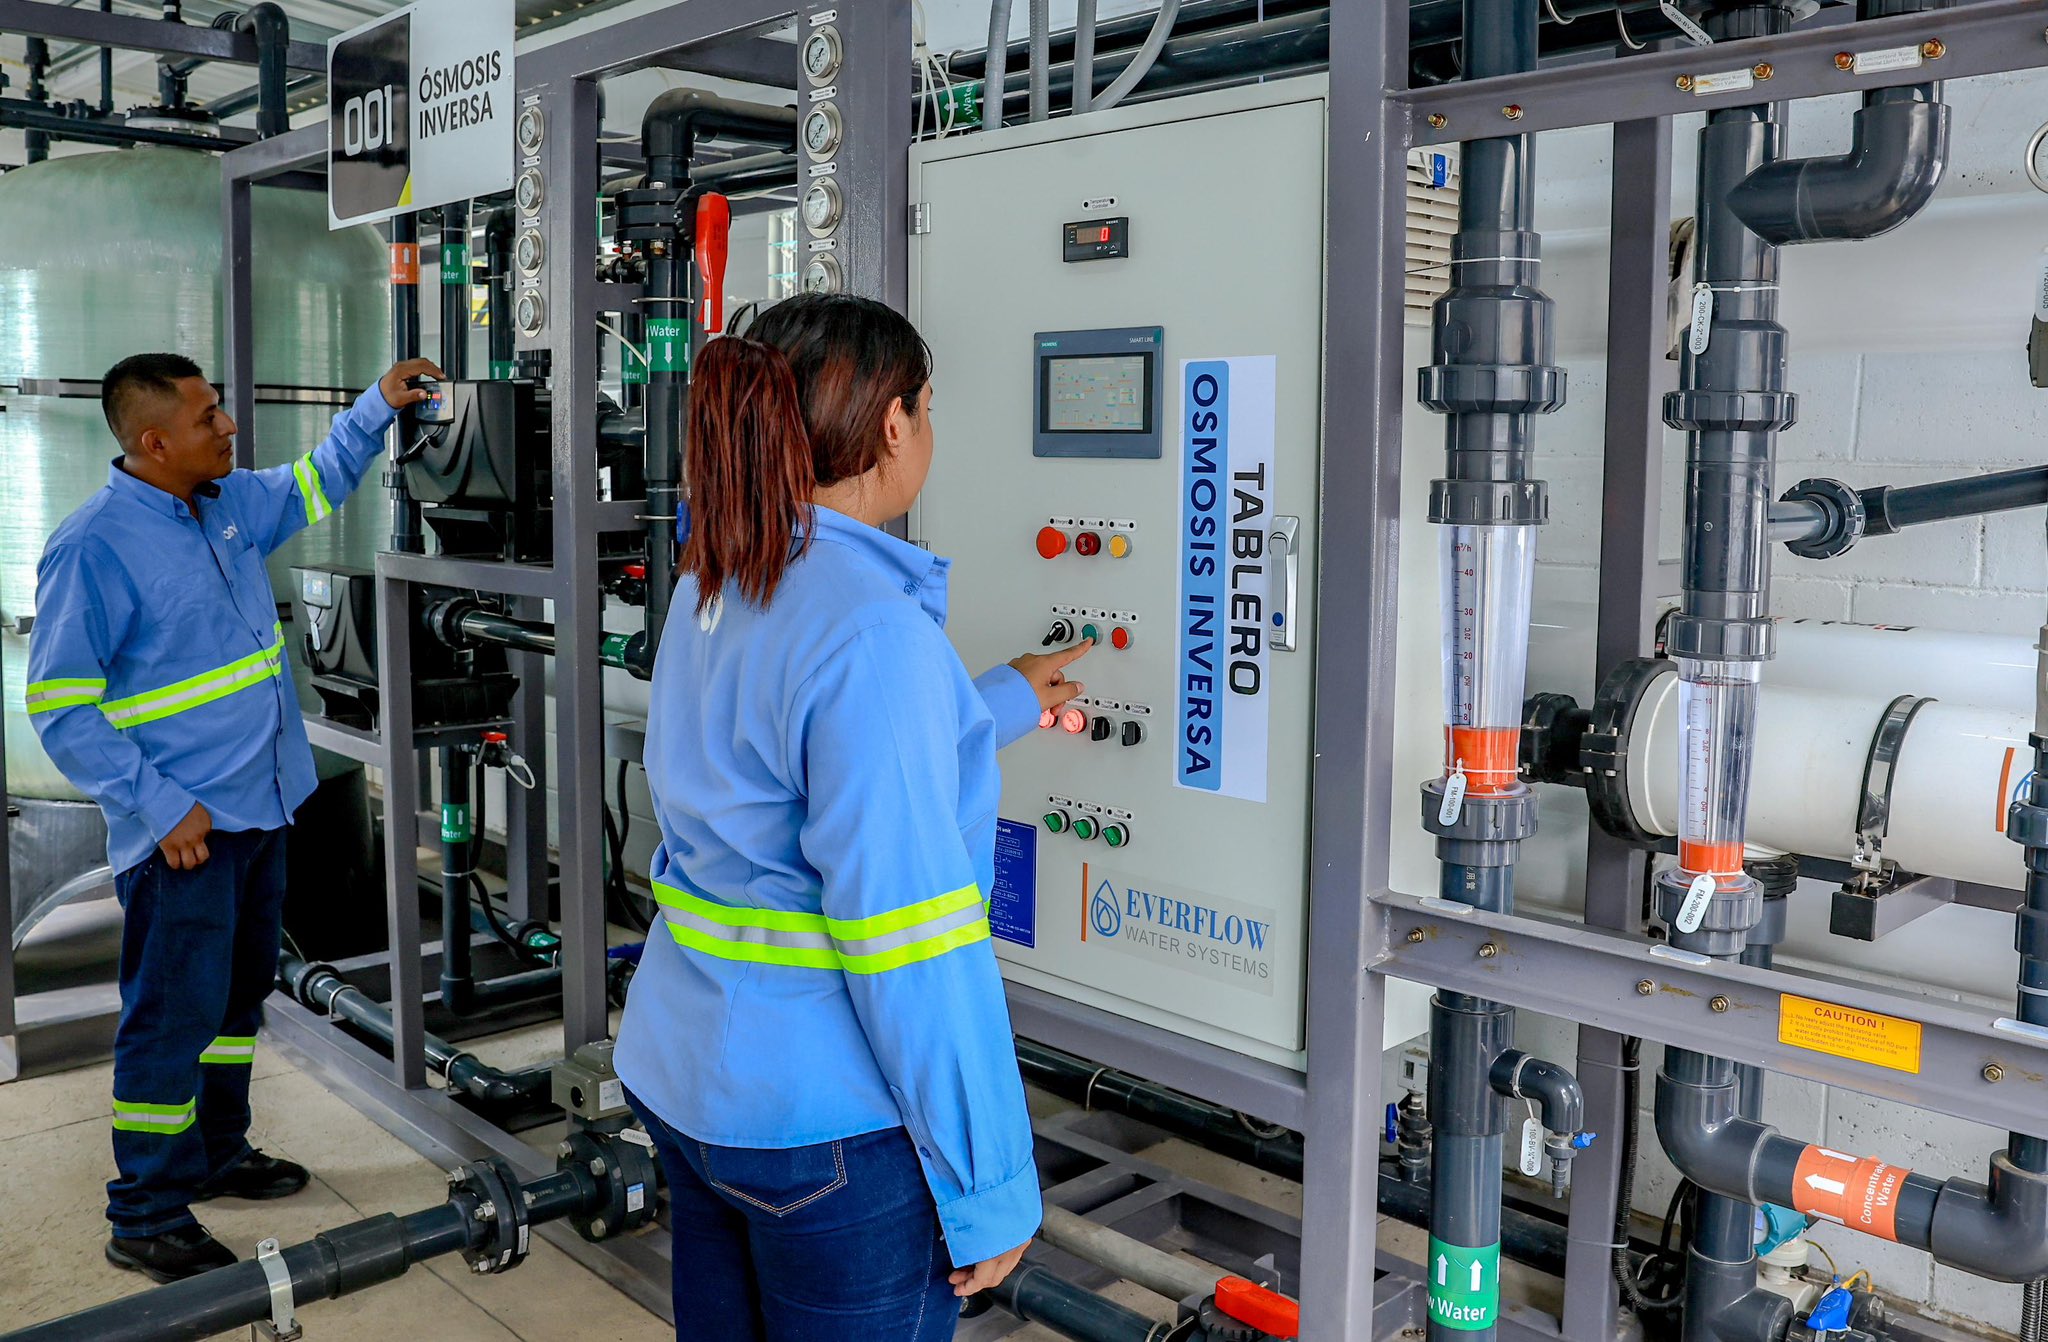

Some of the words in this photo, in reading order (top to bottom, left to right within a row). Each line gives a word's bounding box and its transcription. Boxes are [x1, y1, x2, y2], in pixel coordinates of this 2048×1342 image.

[419, 50, 501, 103] ÓSMOSIS
[344, 84, 393, 157] 001
[419, 91, 493, 139] INVERSA
[441, 271, 459, 279] ater
[649, 325, 681, 337] Water
[622, 370, 641, 380] ater
[1189, 373, 1219, 578] OSMOSIS
[1228, 462, 1265, 697] TABLERO
[1464, 569, 1474, 577] 40
[1464, 608, 1474, 616] 30
[1464, 652, 1473, 660] 20
[1186, 594, 1214, 776] INVERSA
[1463, 703, 1472, 711] 10
[1446, 786, 1459, 819] FM-100-001
[1125, 888, 1270, 952] EVERFLOW
[1684, 889, 1706, 925] FM-200-002
[1125, 924, 1181, 954] WATER
[1186, 942, 1269, 979] SYSTEMS
[1814, 1007, 1877, 1029] CAUTION
[1881, 1021, 1886, 1031] !
[1876, 1173, 1897, 1207] Water
[1437, 1296, 1487, 1321] Water
